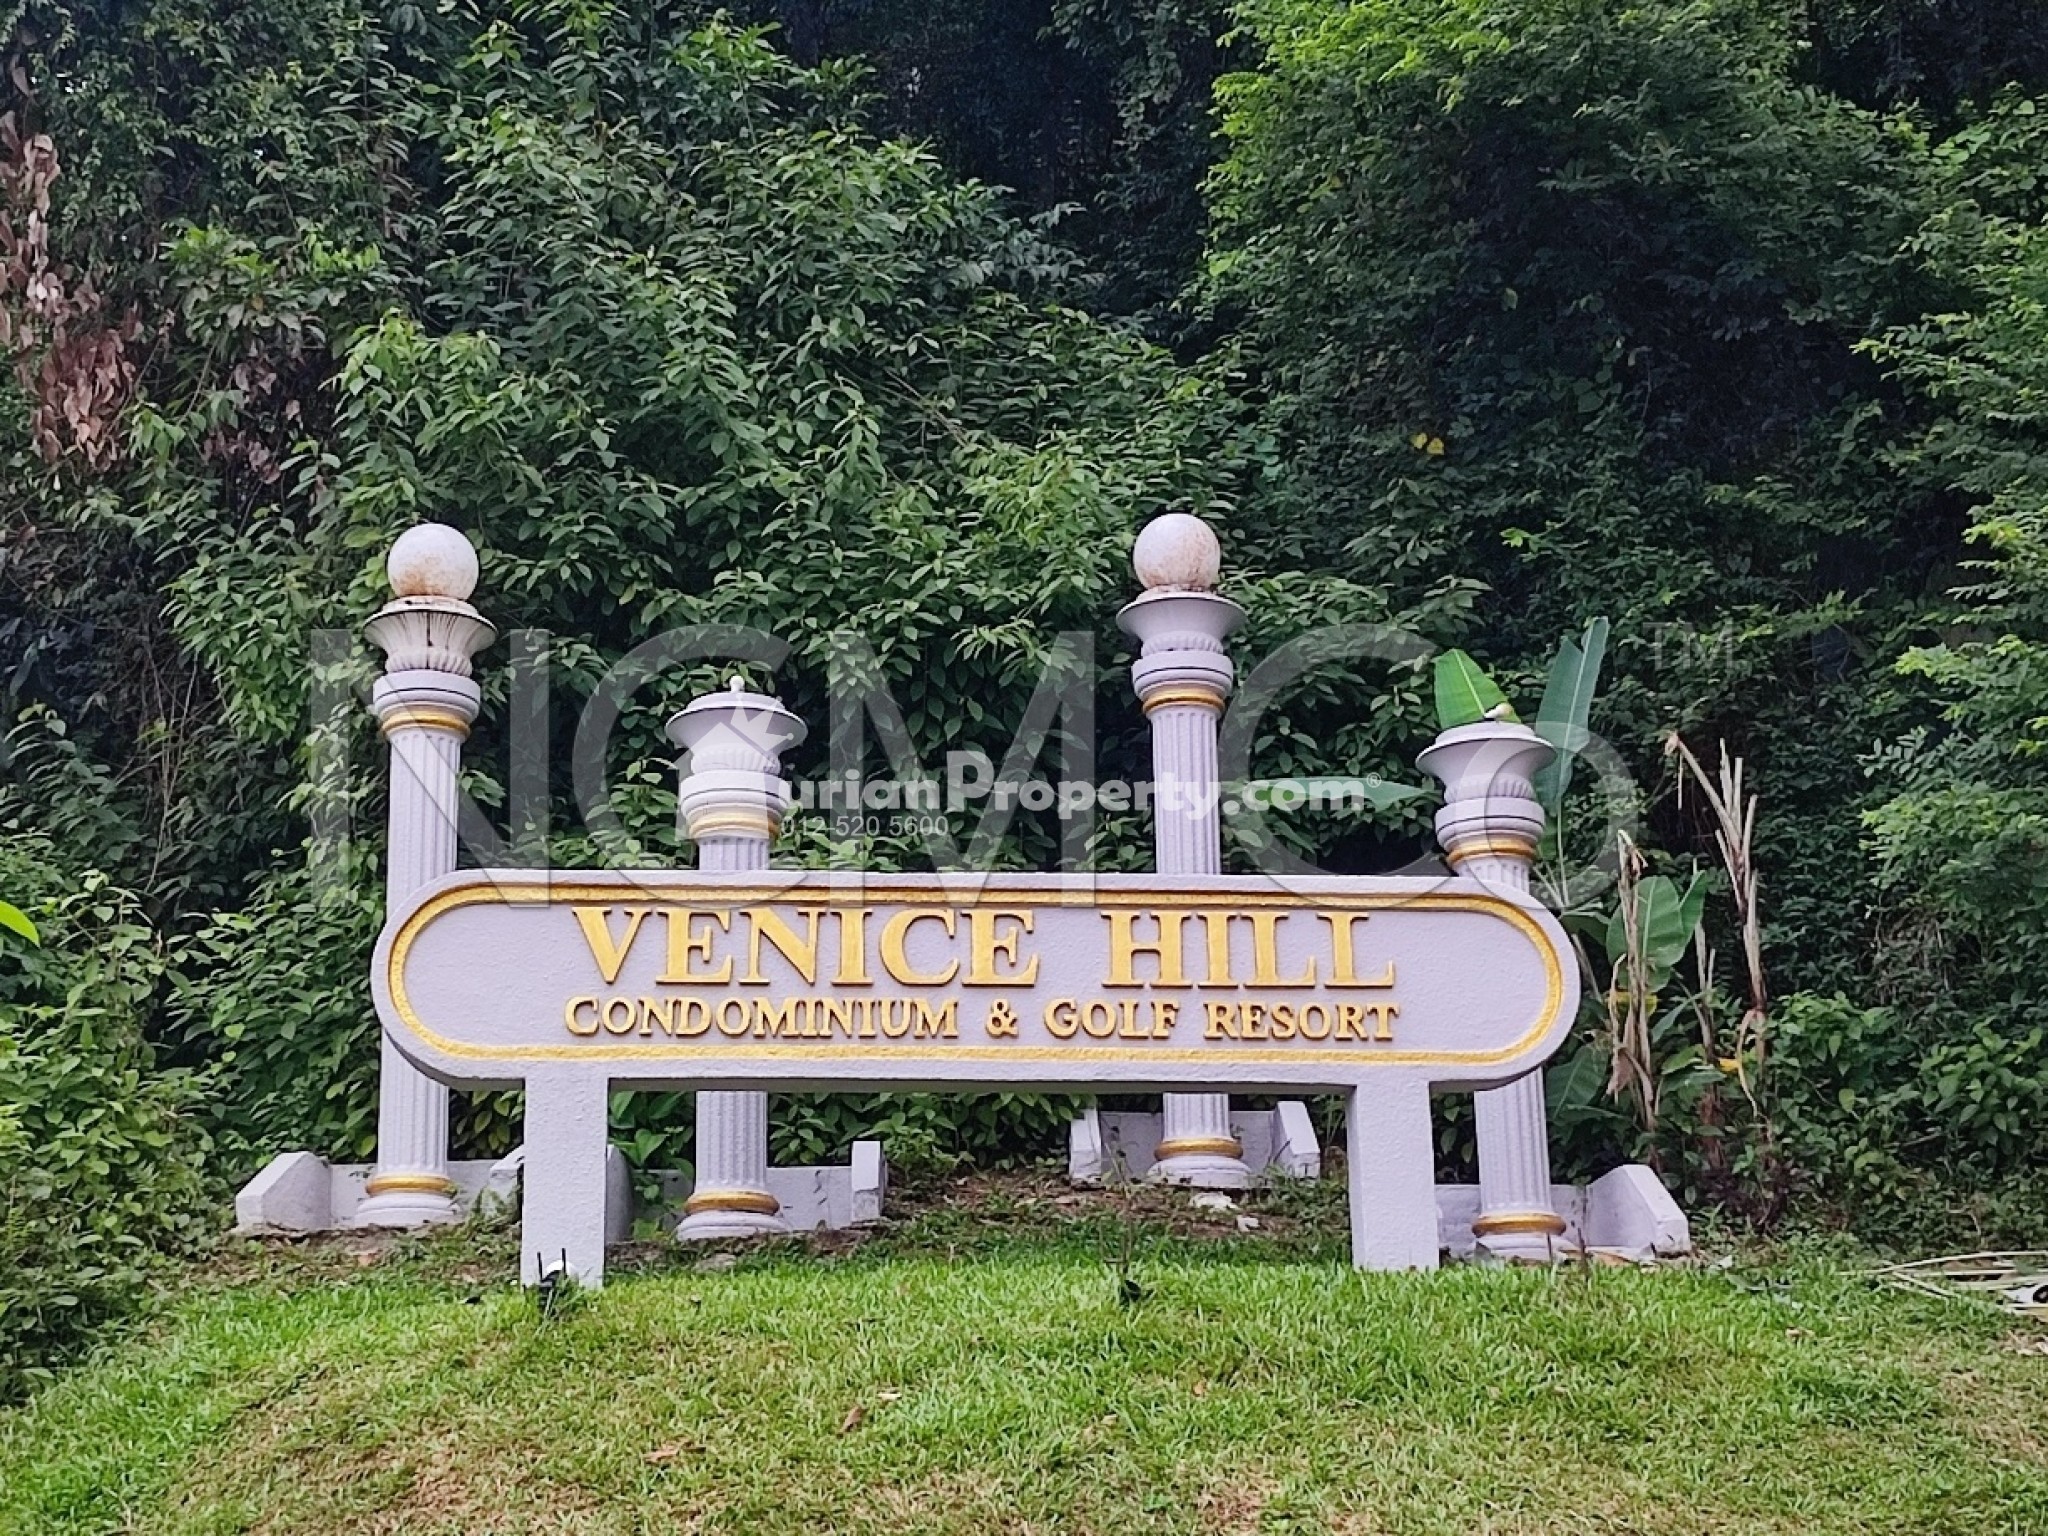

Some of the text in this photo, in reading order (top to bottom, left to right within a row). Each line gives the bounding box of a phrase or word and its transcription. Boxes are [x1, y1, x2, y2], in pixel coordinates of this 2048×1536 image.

[571, 905, 1396, 990] VENICE HILL
[564, 996, 1400, 1042] CONDOMINIUM & GOLF RESORT
